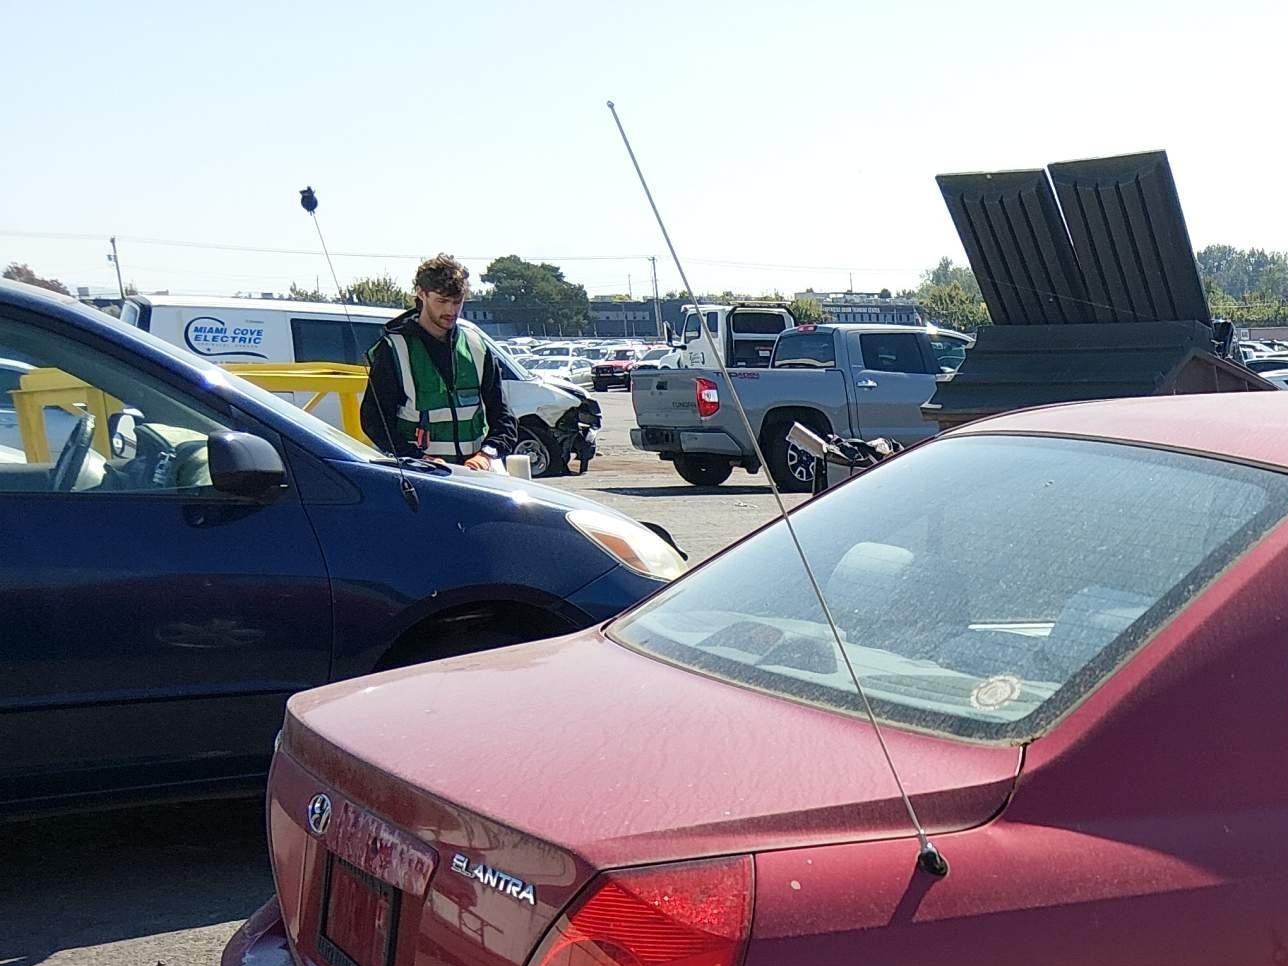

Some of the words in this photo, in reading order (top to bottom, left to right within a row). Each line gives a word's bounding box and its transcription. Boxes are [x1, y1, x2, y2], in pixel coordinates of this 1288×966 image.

[193, 326, 227, 335] MIAMI
[233, 328, 264, 336] COVE
[194, 334, 262, 344] ELECTRIC
[451, 853, 535, 905] ELANTRA
